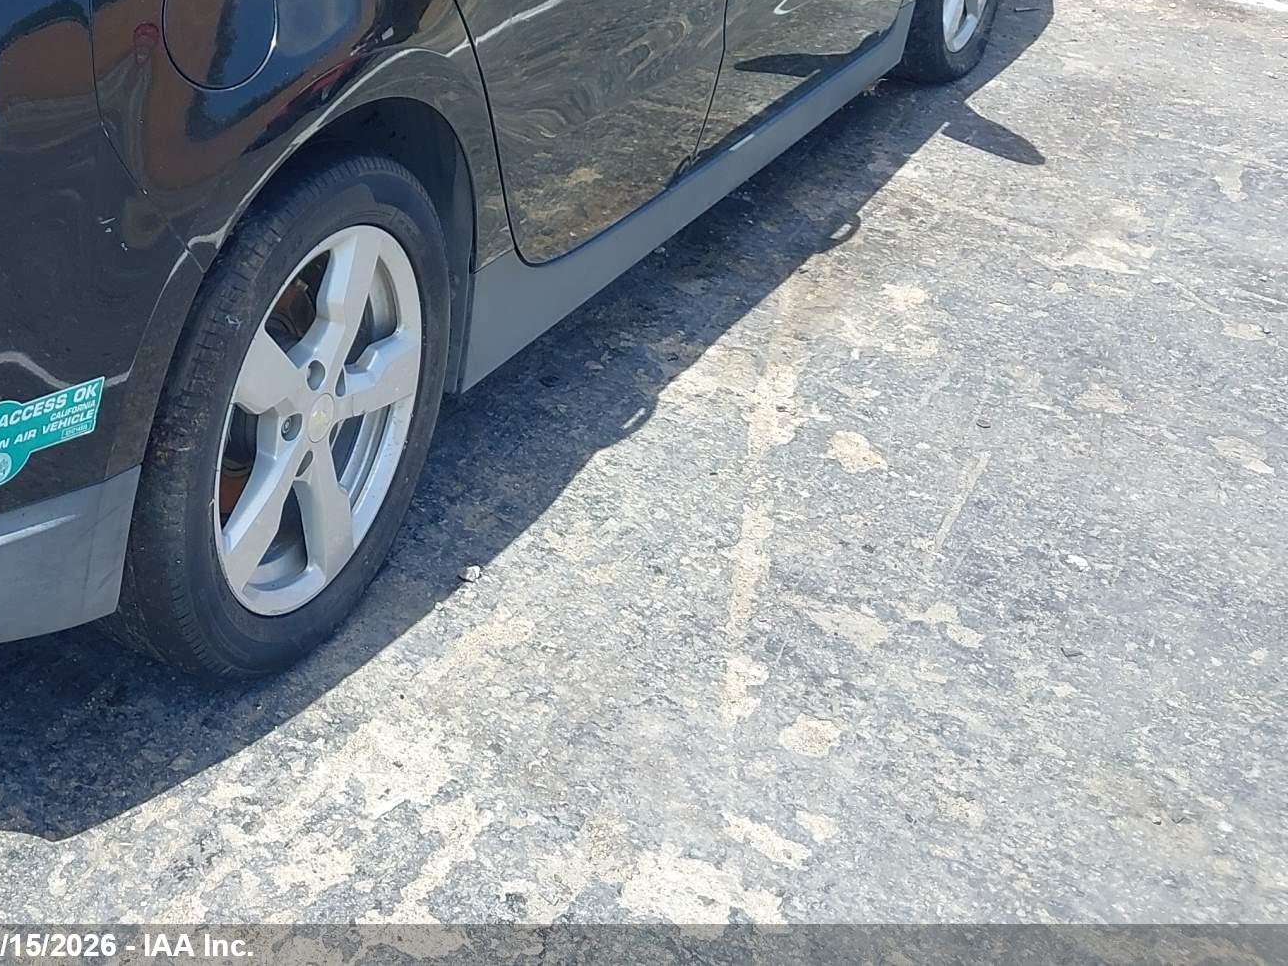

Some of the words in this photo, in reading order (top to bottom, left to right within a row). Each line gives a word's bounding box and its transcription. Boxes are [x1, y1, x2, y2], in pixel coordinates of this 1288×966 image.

[73, 382, 99, 403] OK
[49, 399, 96, 422] CALIFORNIA
[13, 428, 38, 445] AIR
[41, 408, 95, 435] VEHICLE
